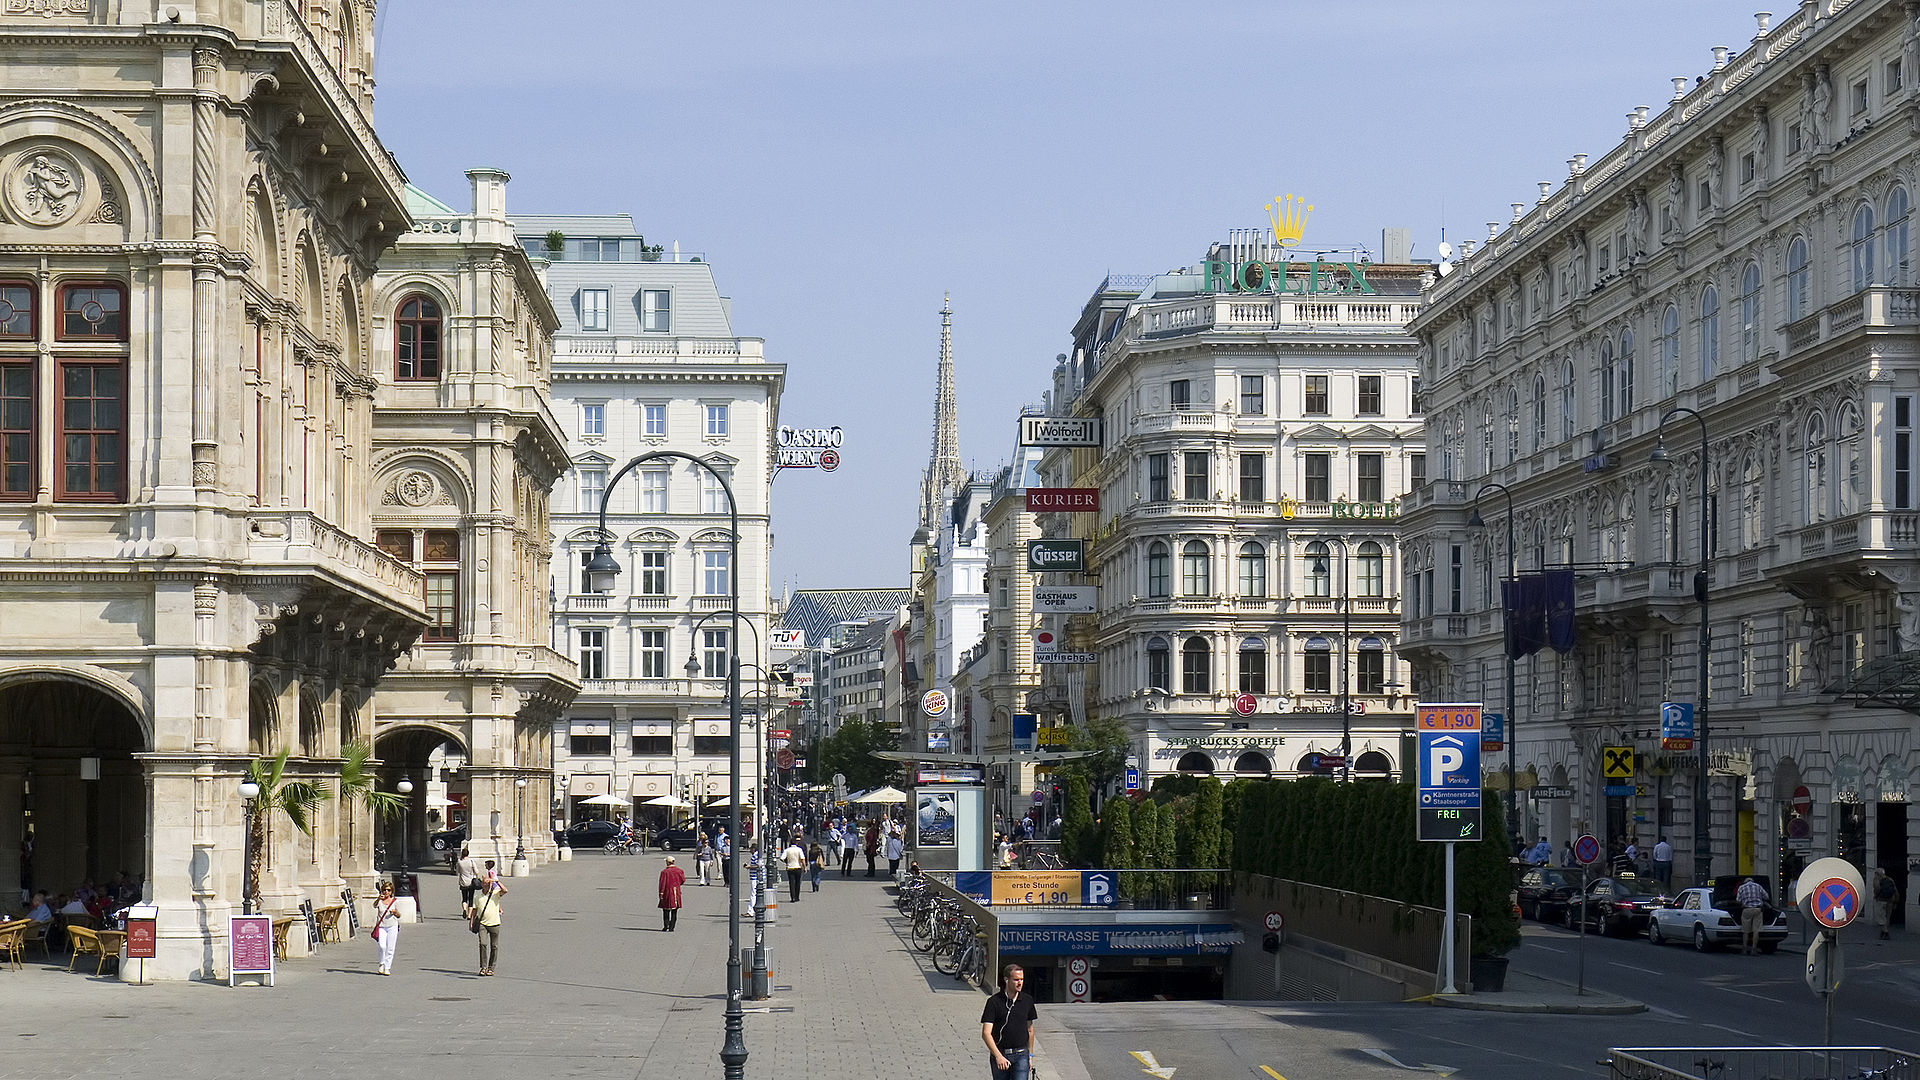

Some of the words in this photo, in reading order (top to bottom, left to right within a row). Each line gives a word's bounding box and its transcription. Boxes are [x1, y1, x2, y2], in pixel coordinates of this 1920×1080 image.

[1200, 259, 1377, 293] ROLEX
[778, 425, 844, 448] CASINO
[1039, 426, 1083, 437] Wolford
[777, 450, 815, 465] WIEN
[1031, 494, 1095, 506] KURIER
[1031, 544, 1078, 566] Gösser
[773, 630, 800, 642] TÜV
[925, 694, 945, 704] BURGER
[926, 700, 946, 710] KING
[1261, 697, 1290, 714] LG
[1425, 713, 1435, 727] €
[1441, 713, 1474, 729] 1,90
[1669, 709, 1683, 727] P
[1483, 718, 1494, 733] P
[1167, 737, 1238, 746] STARBUCKS
[1241, 737, 1285, 746] COFFEE
[1430, 747, 1464, 786] P
[1448, 777, 1470, 785] Parking
[1437, 809, 1460, 819] FREI
[1025, 892, 1033, 904] €
[1090, 880, 1109, 904] P
[1074, 983, 1083, 993] 10
